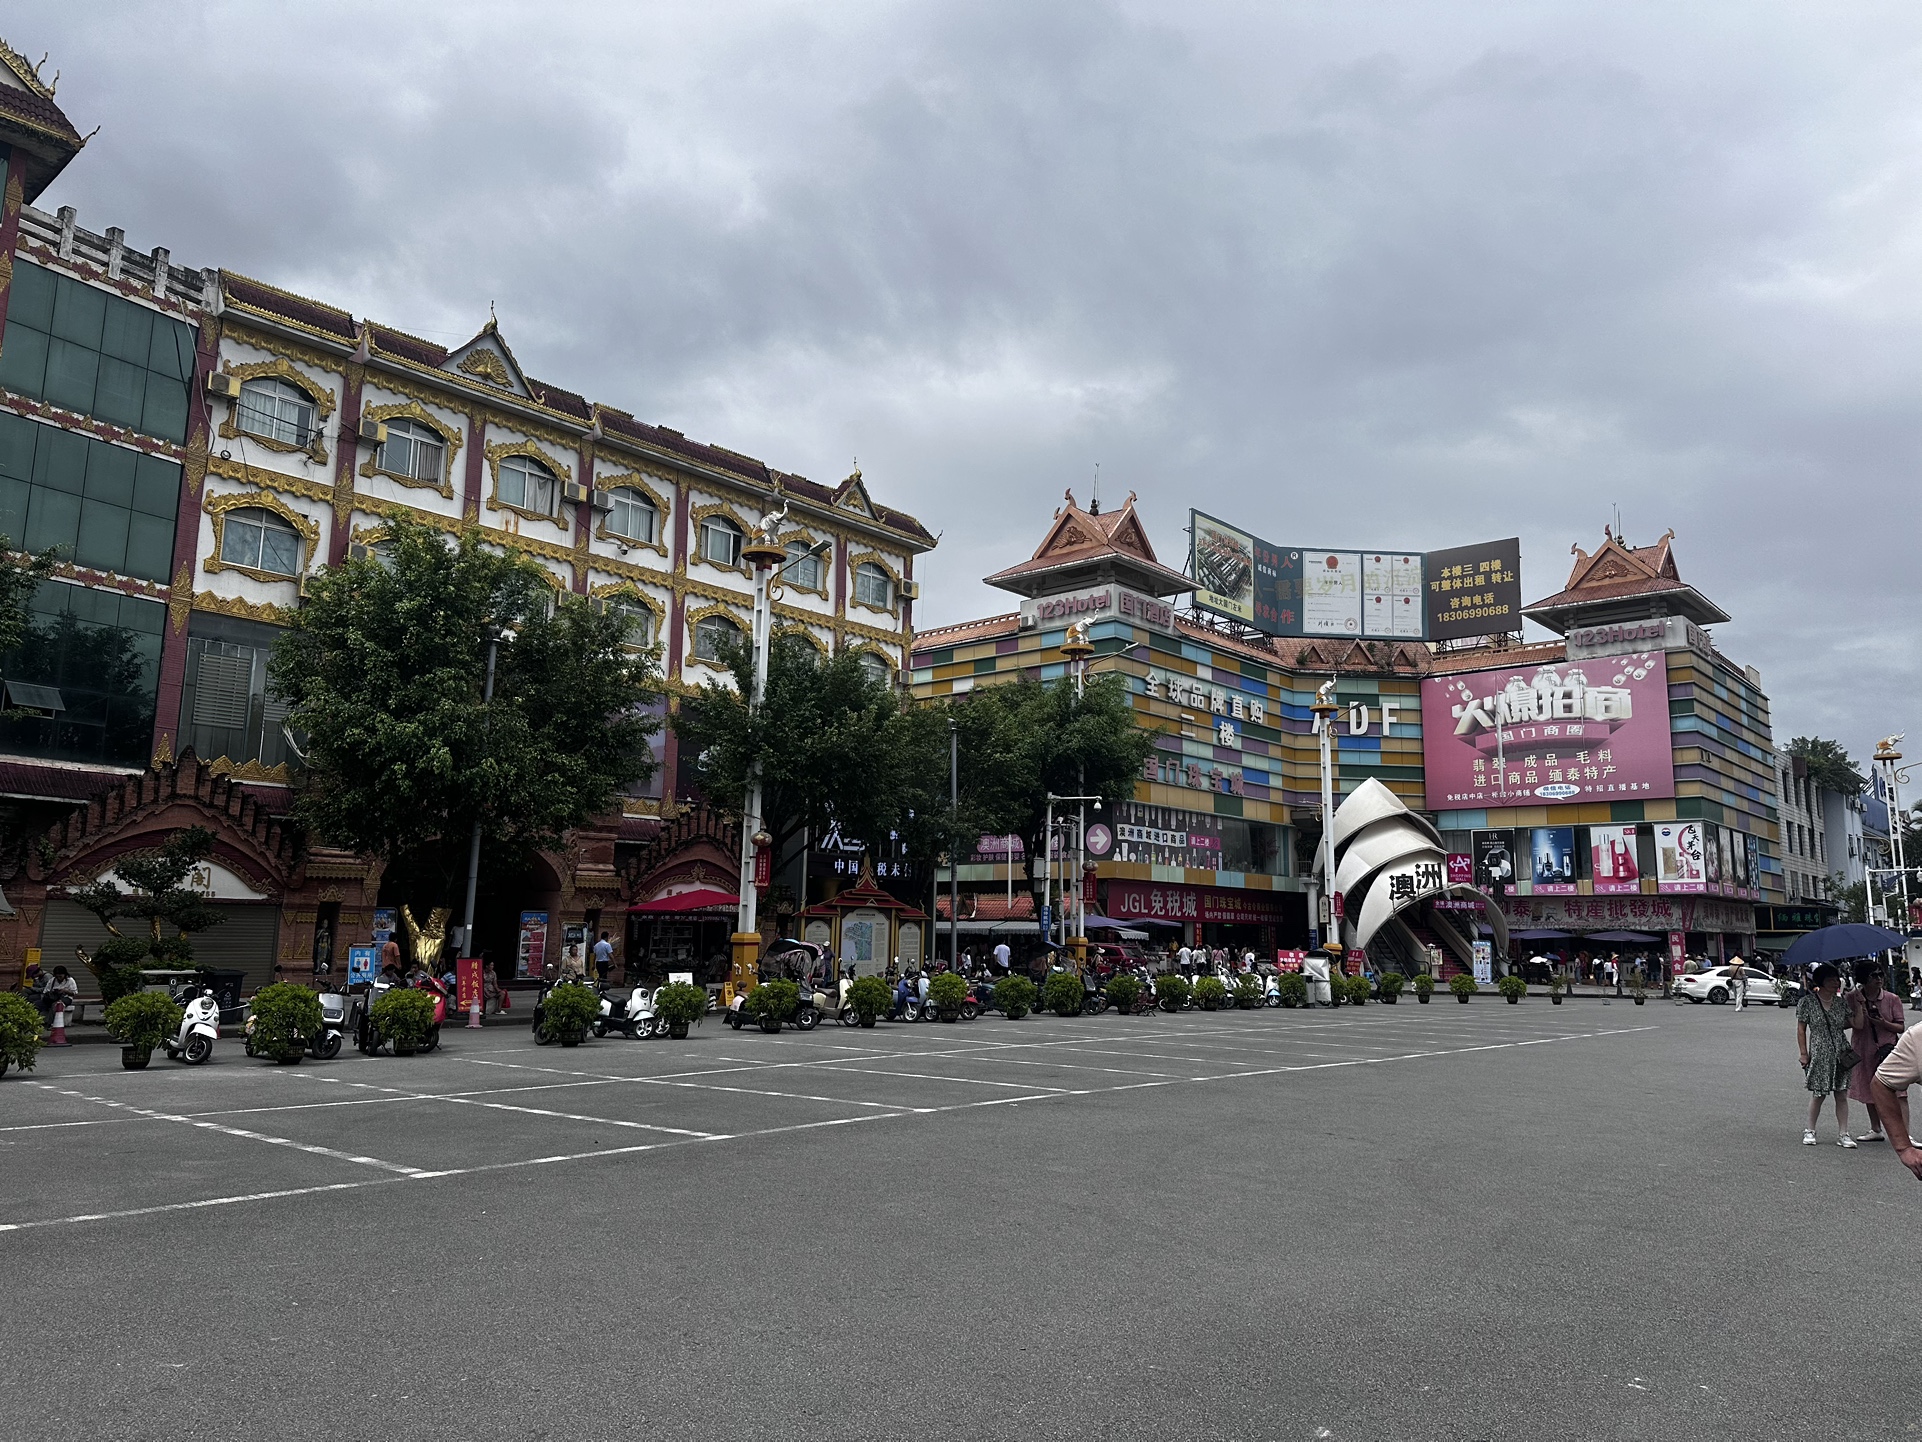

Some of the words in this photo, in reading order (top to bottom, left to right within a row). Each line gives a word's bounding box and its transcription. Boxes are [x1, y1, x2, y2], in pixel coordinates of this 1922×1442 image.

[1441, 564, 1473, 578] 本楼三
[1480, 559, 1501, 572] 四楼
[1430, 574, 1485, 592] 可整体出租
[1491, 571, 1514, 584] 转让
[1037, 590, 1111, 619] 123Hotel
[1120, 591, 1171, 627] 国门酒店
[1450, 592, 1494, 609] 咨询电话
[1437, 604, 1509, 622] 18306990688
[1574, 620, 1664, 647] 123Hotel
[1145, 671, 1263, 723] 全球品牌直购
[1452, 686, 1632, 735] 火爆招商
[1473, 757, 1506, 772] 翡翠
[1524, 753, 1558, 768] 成品
[1576, 749, 1612, 764] 毛料
[1144, 755, 1244, 796] 国门珠宝城
[1473, 771, 1538, 787] 进口商品
[1548, 765, 1617, 782] 缅泰特产
[1547, 884, 1575, 892] 请上二楼
[1608, 884, 1637, 892] 请上二楼
[1674, 884, 1704, 892] 请上二楼
[1564, 899, 1673, 918] 特產批發城
